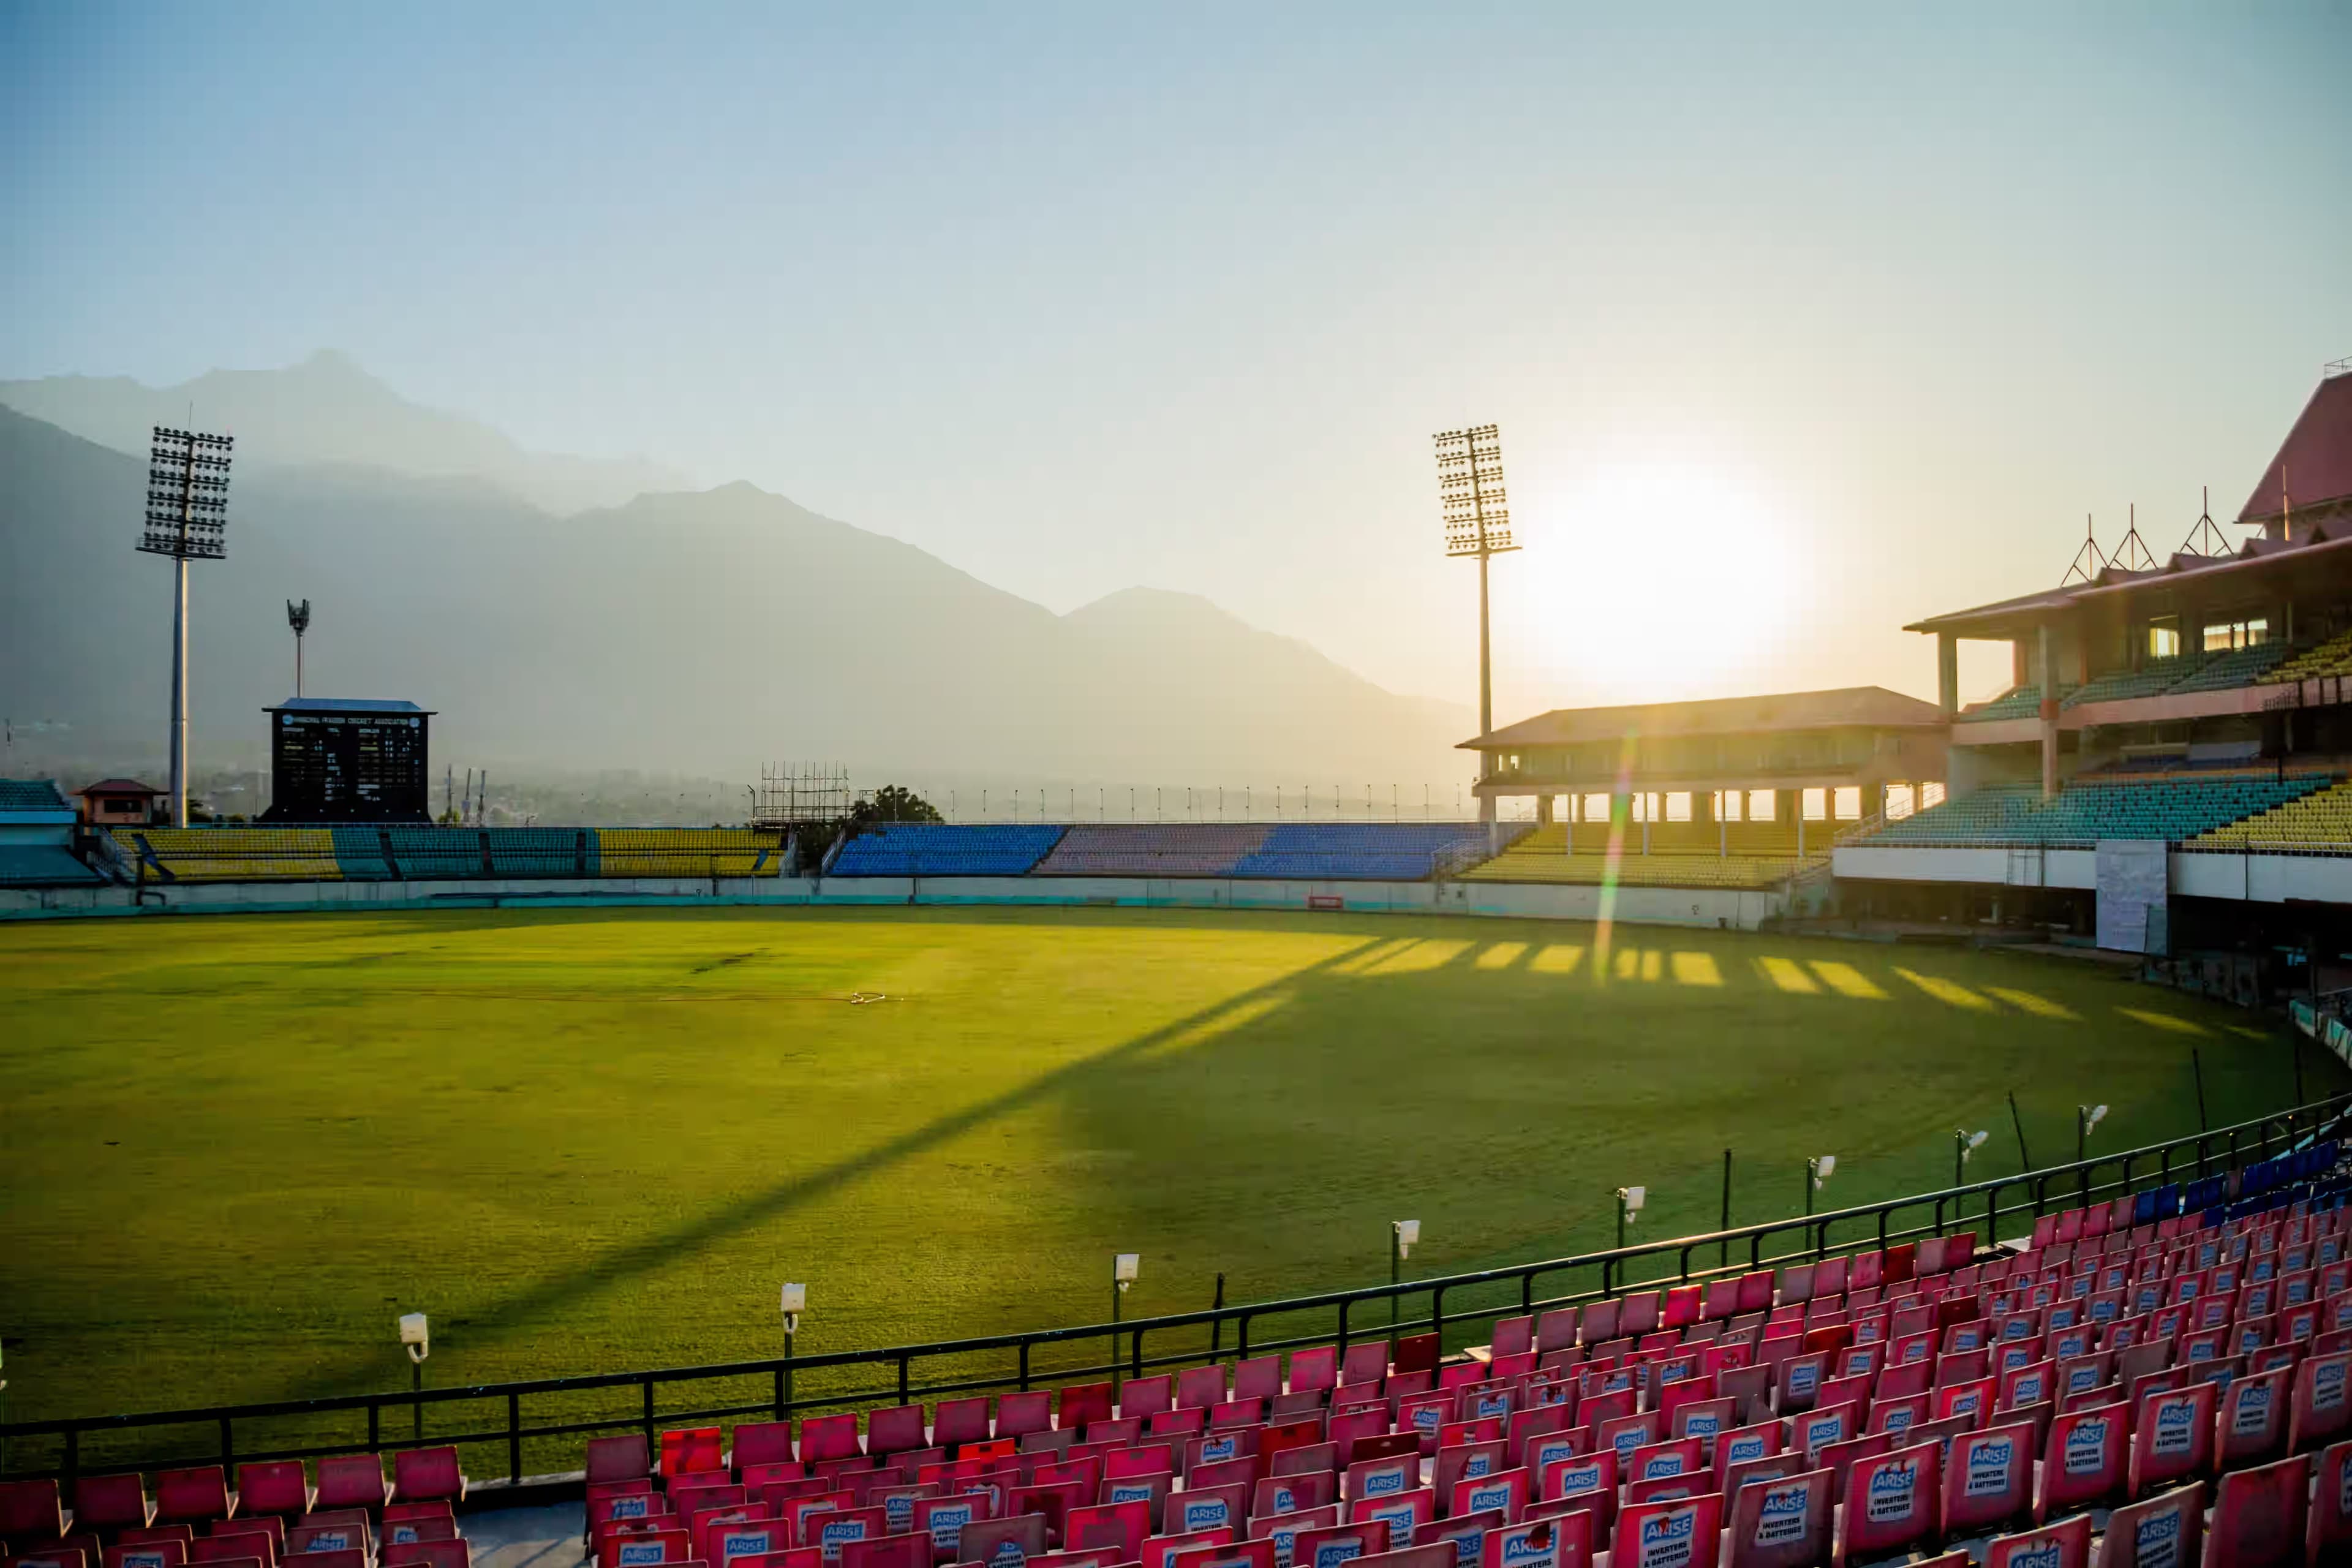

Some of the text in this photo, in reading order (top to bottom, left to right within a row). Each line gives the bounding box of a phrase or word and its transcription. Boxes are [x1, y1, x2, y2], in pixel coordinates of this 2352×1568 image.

[1887, 1413, 1910, 1426] ARISE
[2160, 1407, 2193, 1422] ARISE
[1690, 1420, 1716, 1431] ARISE
[1811, 1423, 1838, 1437] ARISE
[1616, 1434, 1643, 1447] ARISE
[2070, 1428, 2103, 1442] ARISE
[1543, 1449, 1571, 1460] ARISE
[1733, 1444, 1760, 1457] ARISE
[1972, 1447, 2009, 1463] ARISE
[1649, 1463, 1679, 1475] ARISE
[1972, 1469, 2004, 1480] INVERTERS
[1370, 1475, 1401, 1488] ARISE
[1567, 1472, 1597, 1487] ARISE
[1875, 1471, 1912, 1487] ARISE
[1474, 1492, 1506, 1507] ARISE
[1874, 1494, 1909, 1506] INVERTERS
[1190, 1507, 1223, 1520] ARISE
[1877, 1503, 1910, 1515] BATTERIES
[935, 1513, 967, 1526] ARISE
[1763, 1517, 1800, 1529] INVERTERS
[1766, 1526, 1801, 1539] BATTERIES
[2139, 1517, 2177, 1539] ARISE
[1648, 1542, 1687, 1556] INVERTERS
[1652, 1550, 1689, 1566] BATTERIES
[2016, 1551, 2057, 1568] ARISE
